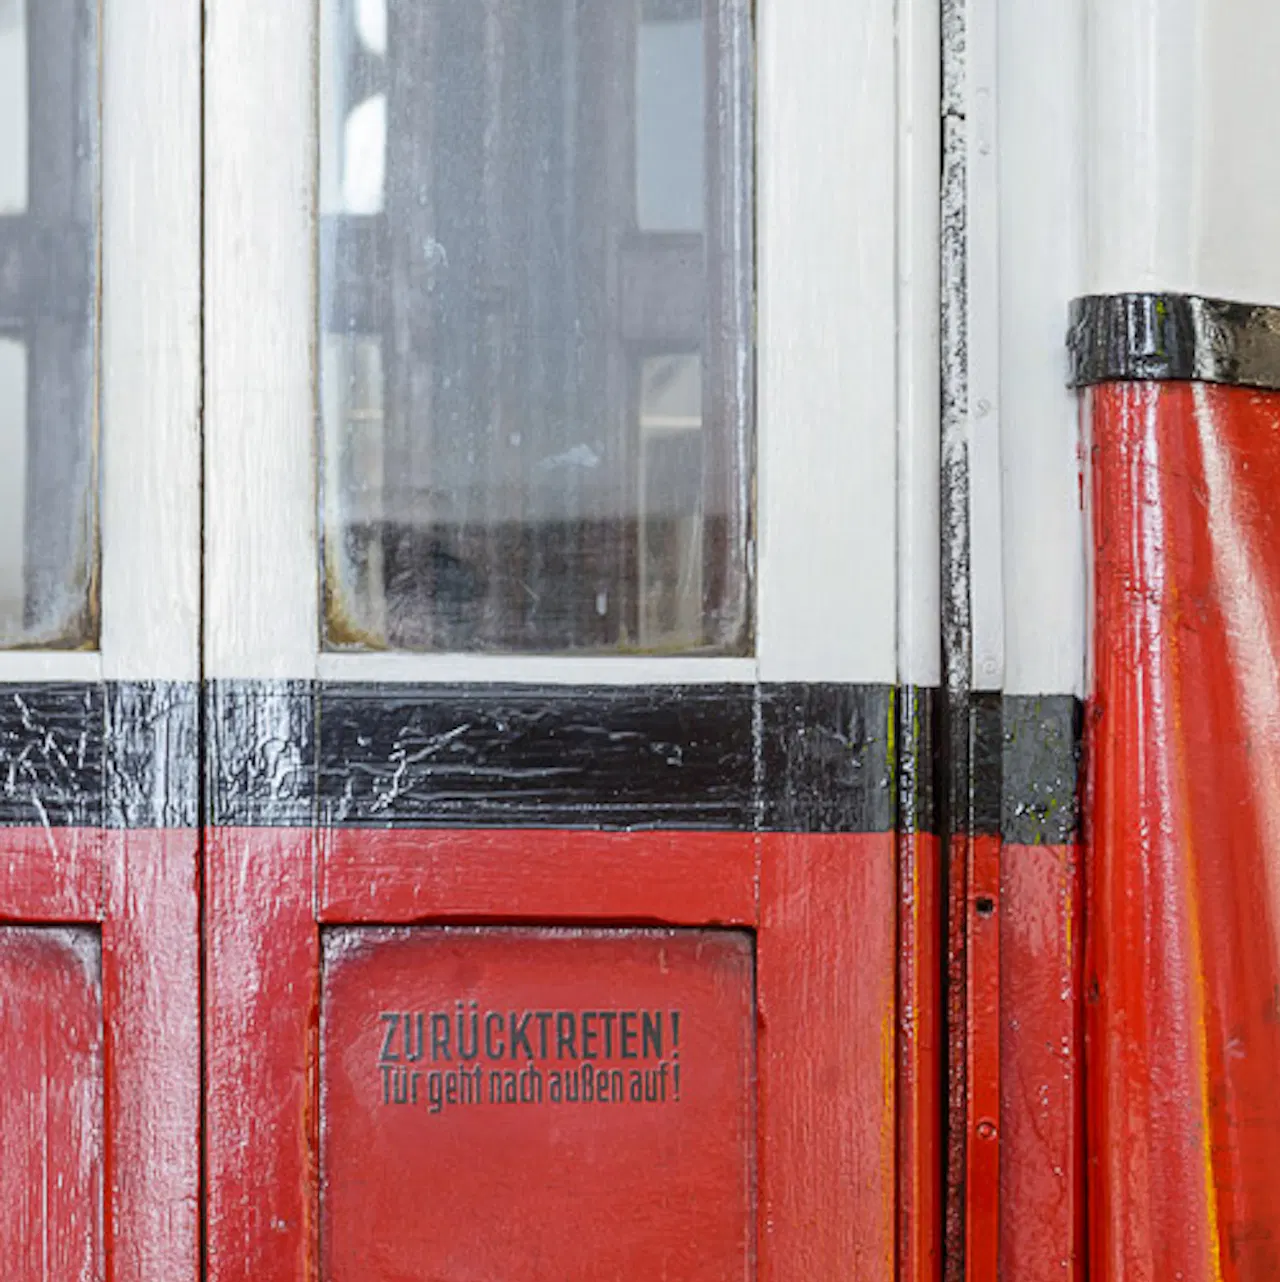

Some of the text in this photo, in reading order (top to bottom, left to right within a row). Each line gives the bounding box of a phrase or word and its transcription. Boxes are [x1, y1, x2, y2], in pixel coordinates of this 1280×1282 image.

[378, 1001, 681, 1060] ZURÜCKTRETEN!
[378, 1061, 681, 1113] Tür geht nach außen auf!
